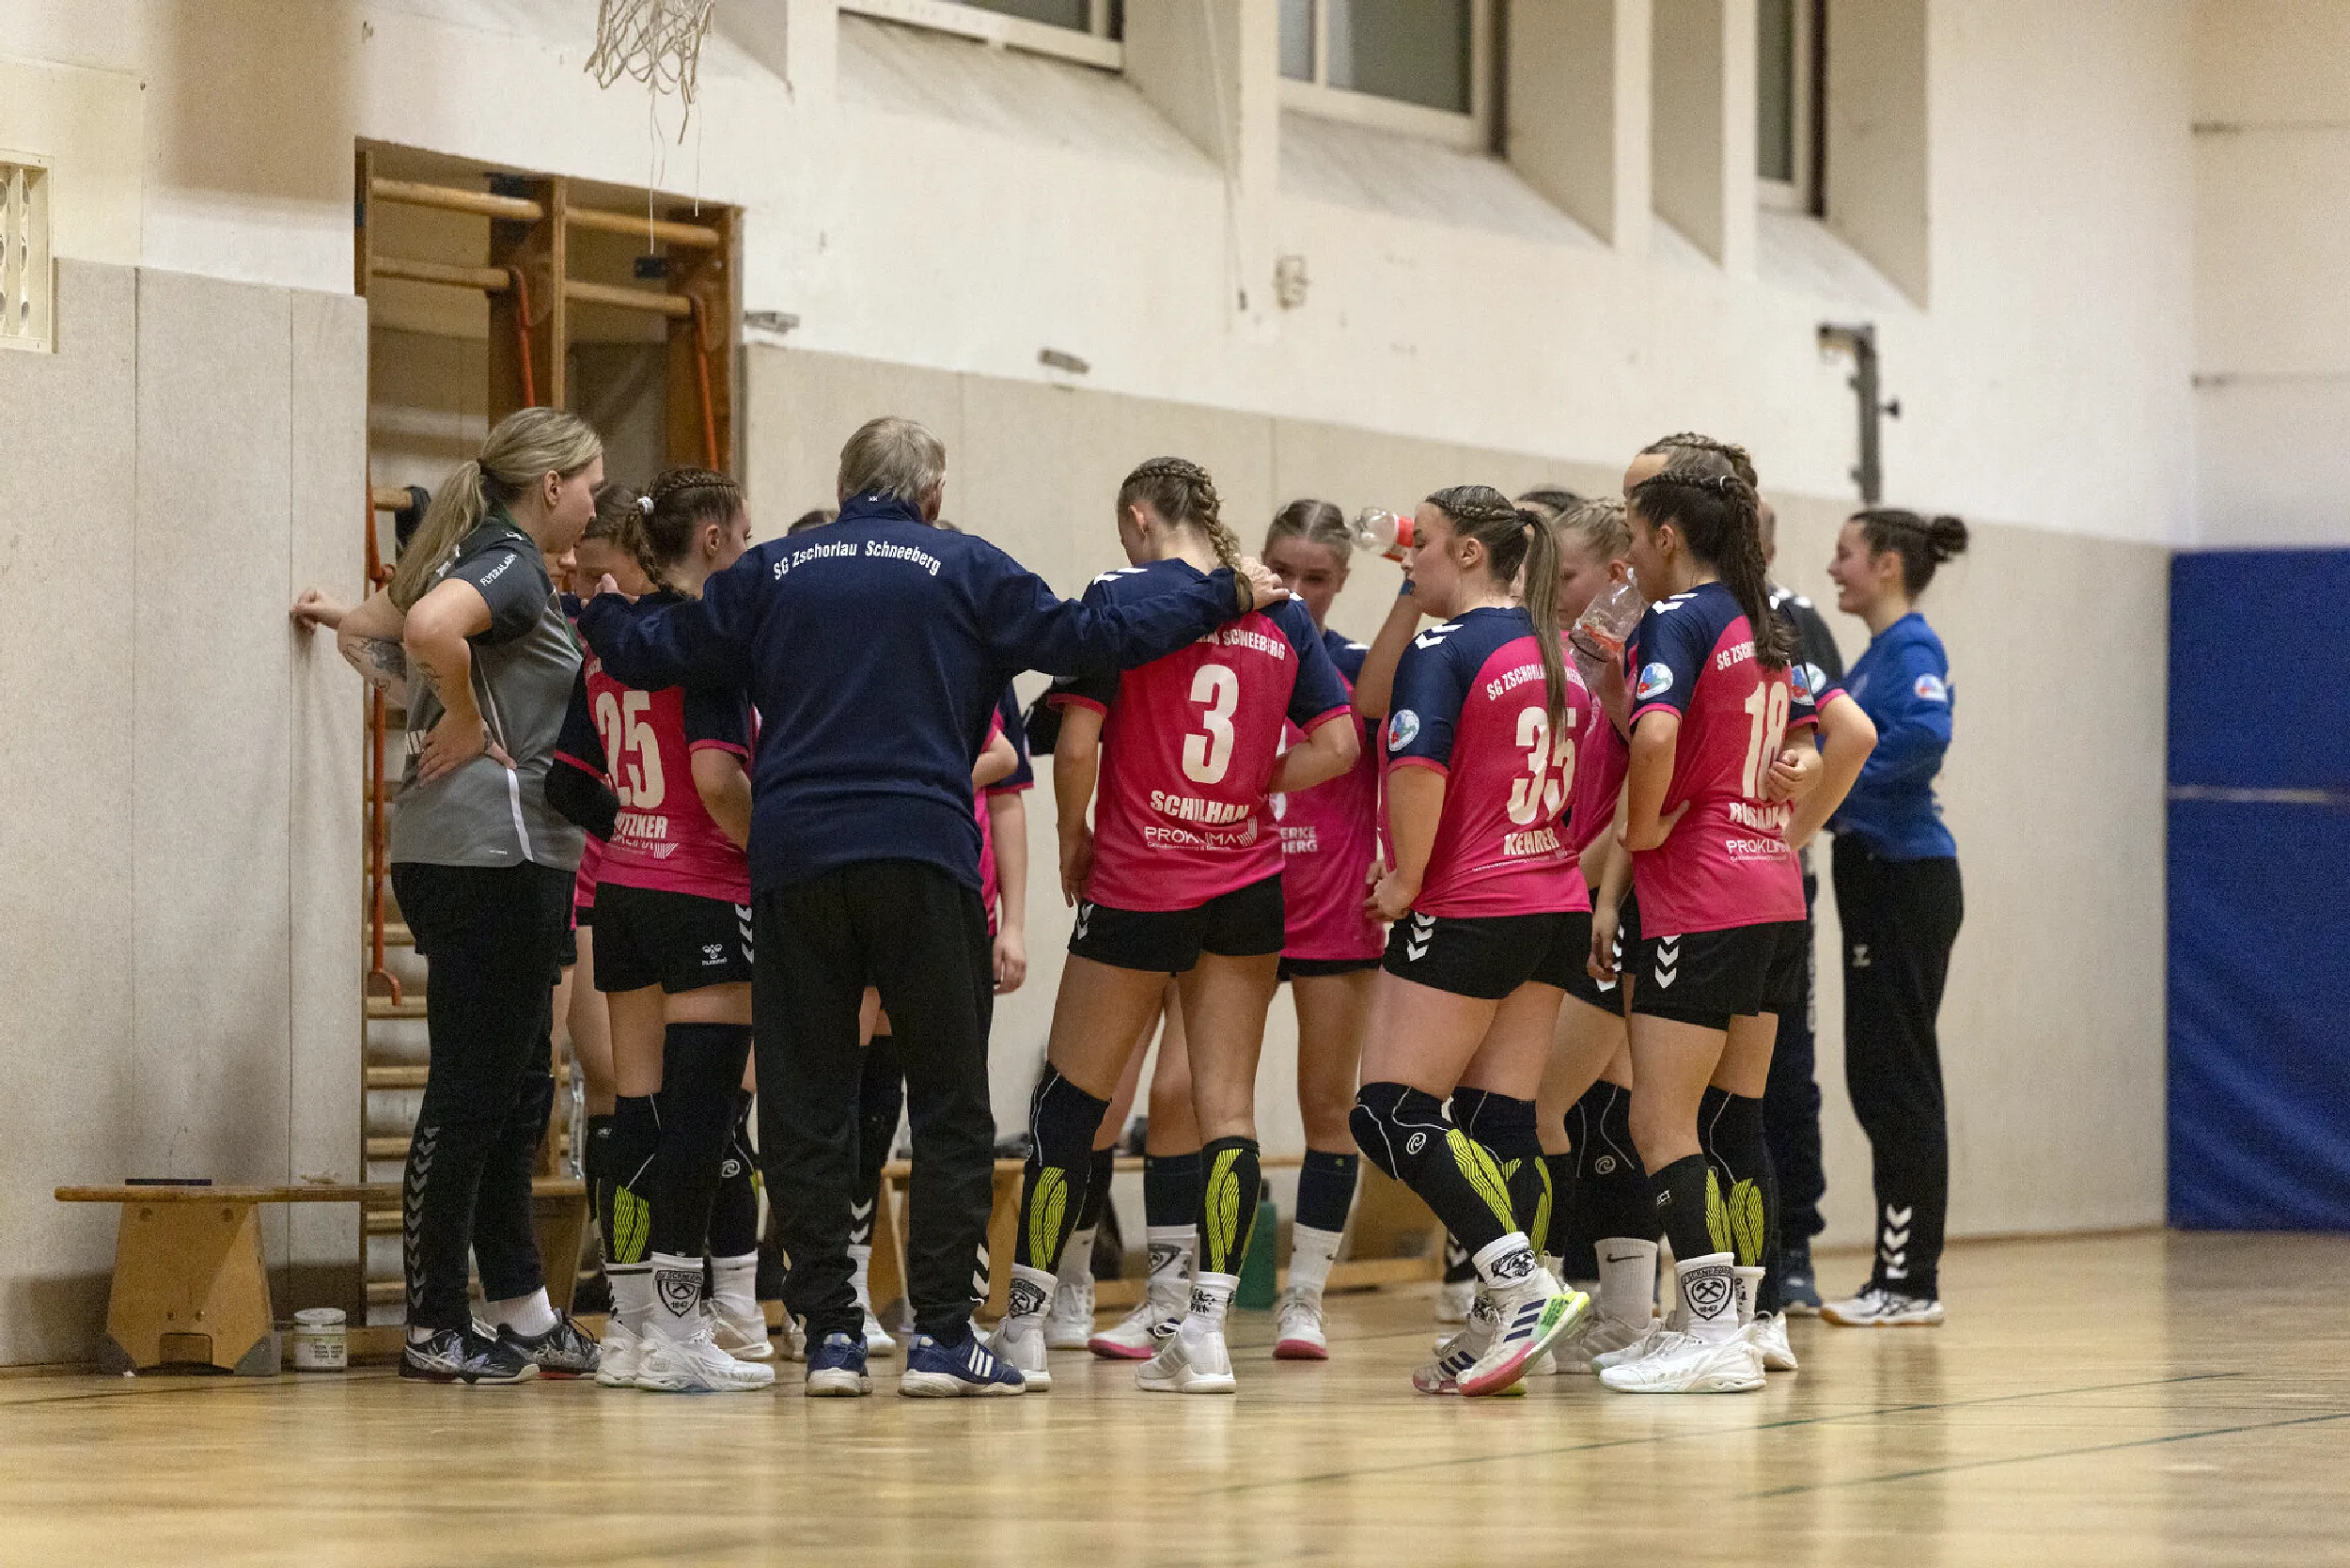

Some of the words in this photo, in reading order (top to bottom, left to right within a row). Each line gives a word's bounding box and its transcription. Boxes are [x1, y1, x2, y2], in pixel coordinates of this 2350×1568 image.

[774, 557, 789, 580] SG
[792, 541, 857, 568] Zschorlau
[865, 541, 941, 576] Schneeberg
[1486, 679, 1504, 700] SG
[1717, 651, 1731, 670] SG
[596, 690, 666, 808] 25
[1182, 664, 1239, 784] 3
[1507, 707, 1577, 825] 35
[1743, 682, 1788, 800] 18
